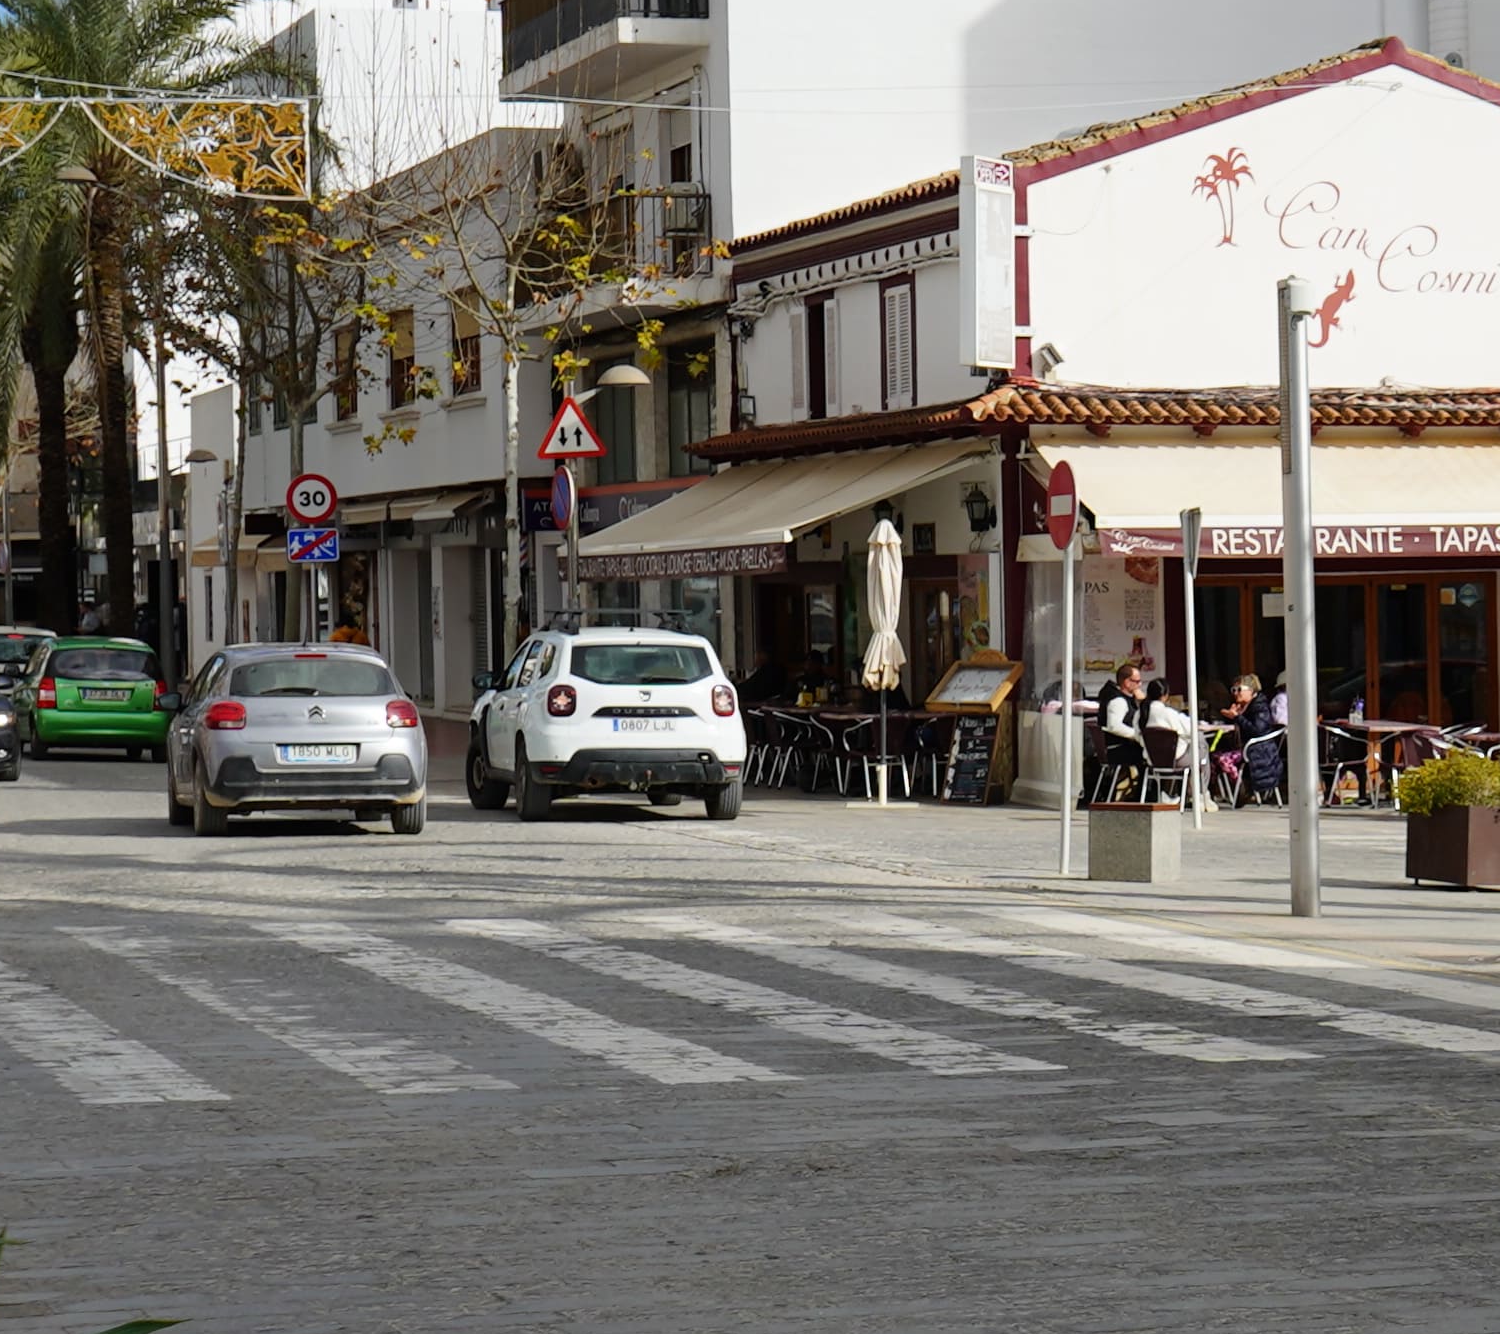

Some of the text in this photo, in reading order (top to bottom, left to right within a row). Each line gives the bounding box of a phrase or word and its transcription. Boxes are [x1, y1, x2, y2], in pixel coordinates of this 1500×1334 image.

[299, 491, 326, 507] 30
[1212, 527, 1404, 555] RESTARANTE
[1084, 581, 1110, 594] PAS
